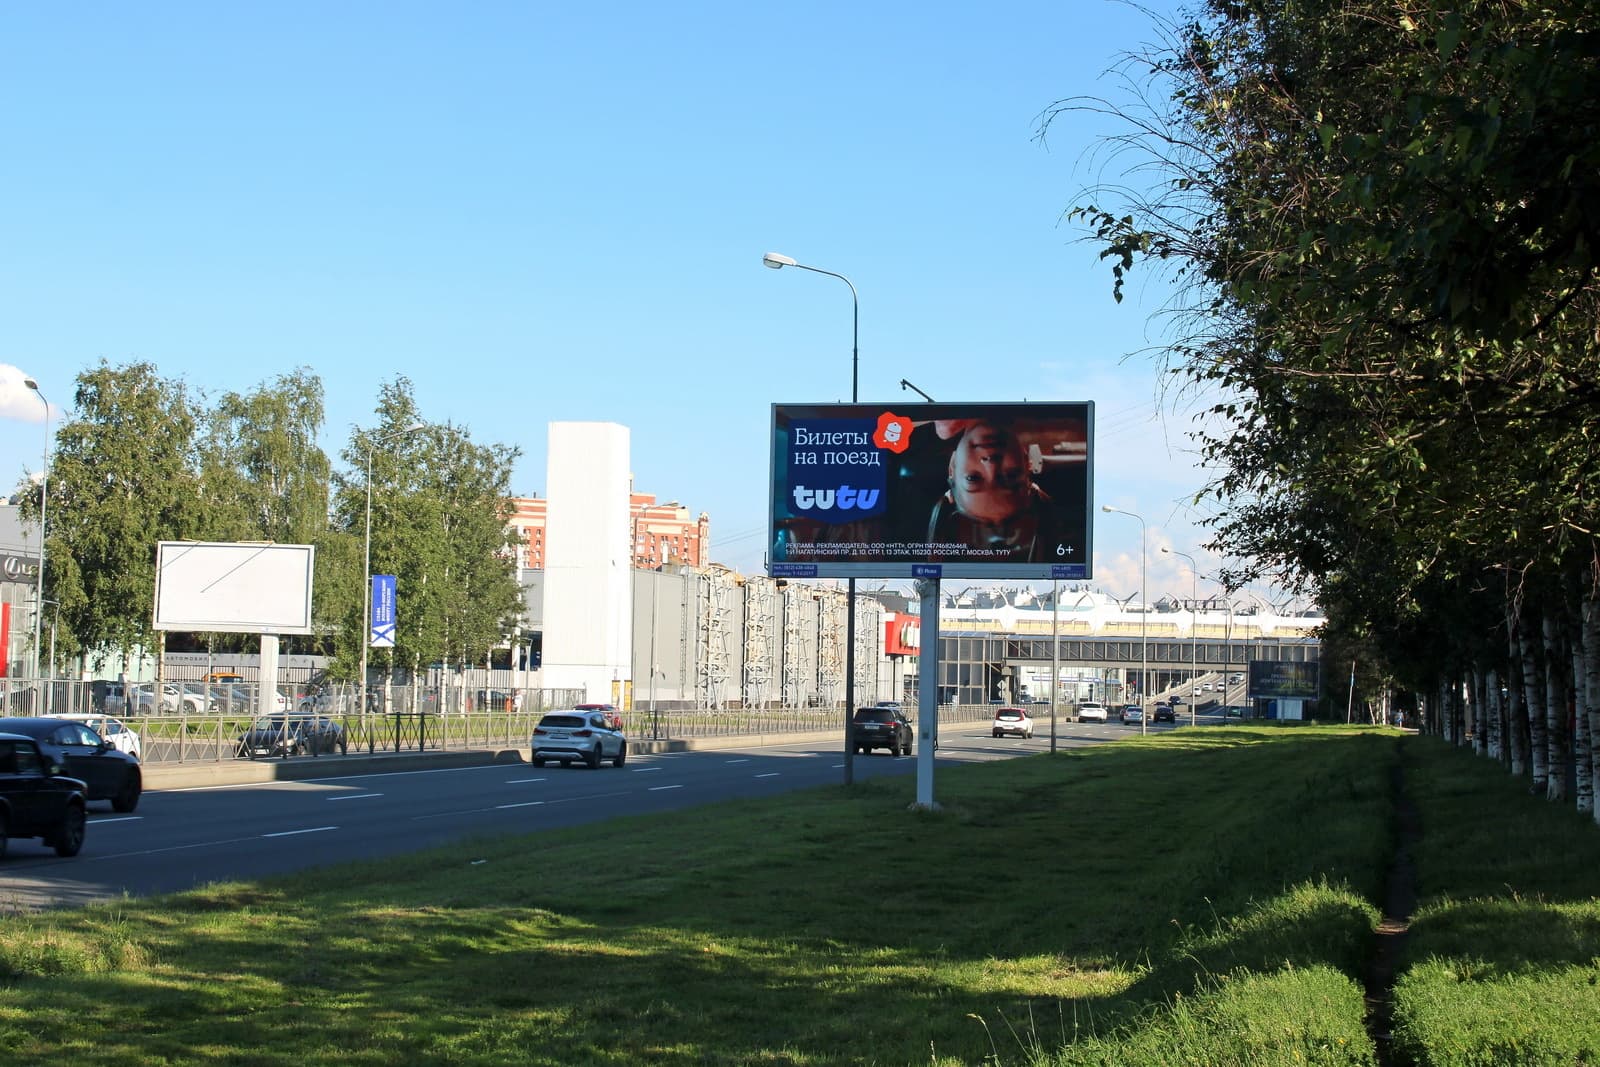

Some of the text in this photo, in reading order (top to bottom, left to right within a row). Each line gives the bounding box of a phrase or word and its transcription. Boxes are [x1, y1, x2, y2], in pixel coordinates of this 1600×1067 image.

[794, 427, 869, 446] Билеты
[794, 451, 881, 467] на поезд
[793, 485, 880, 510] tutu
[1056, 543, 1074, 556] 6+
